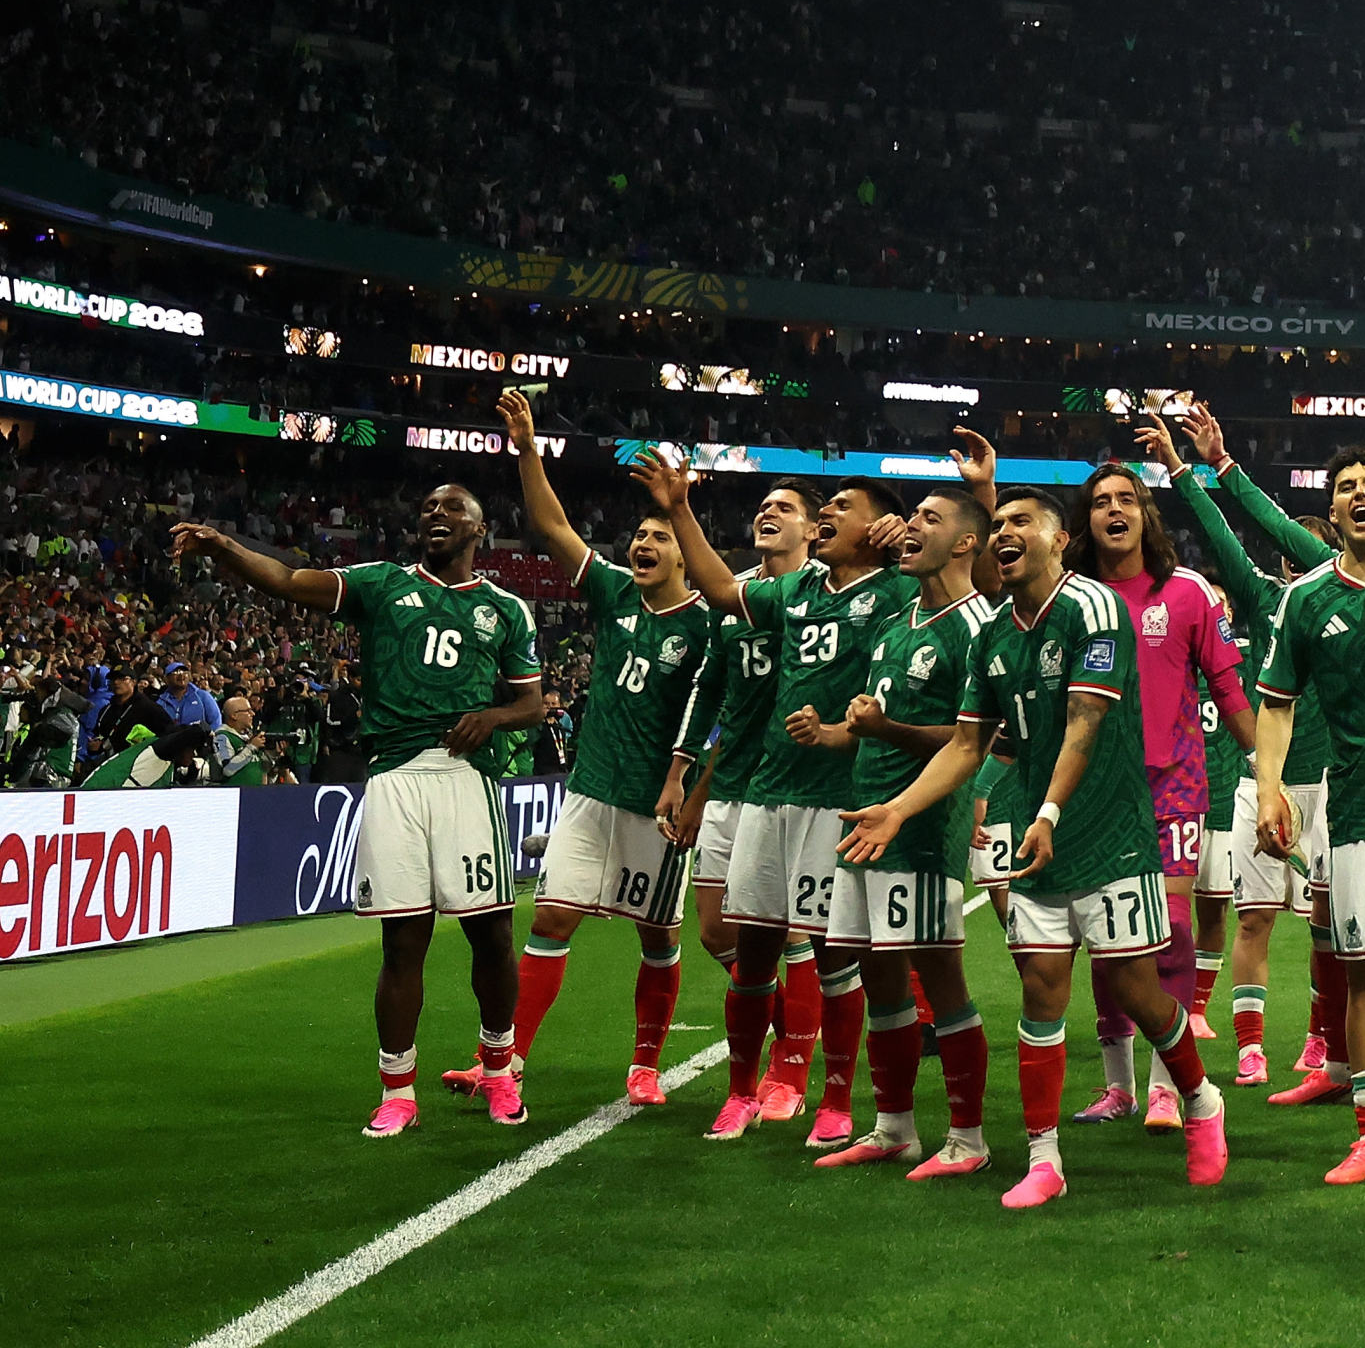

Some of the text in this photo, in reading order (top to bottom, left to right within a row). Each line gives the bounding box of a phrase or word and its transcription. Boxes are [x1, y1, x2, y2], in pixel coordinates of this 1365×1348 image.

[13, 278, 83, 315] WORLD
[88, 294, 128, 322] CUP
[128, 302, 204, 336] 2026
[1146, 312, 1355, 335] MEXICO CITY
[410, 344, 569, 378] MEXICO CITY
[5, 375, 77, 409] WORLD
[78, 387, 121, 414] CUP
[121, 393, 199, 425] 2026
[406, 427, 501, 454] MEXICO
[423, 626, 462, 668] 16
[739, 638, 772, 679] 15
[799, 622, 838, 664] 23
[616, 650, 650, 694] 18
[1198, 700, 1219, 733] 9
[1169, 821, 1200, 862] 12
[0, 794, 173, 957] erizon
[462, 853, 493, 893] 16
[617, 866, 650, 907] 18
[797, 874, 834, 917] 23
[887, 885, 908, 928] 6
[1102, 892, 1140, 940] 17
